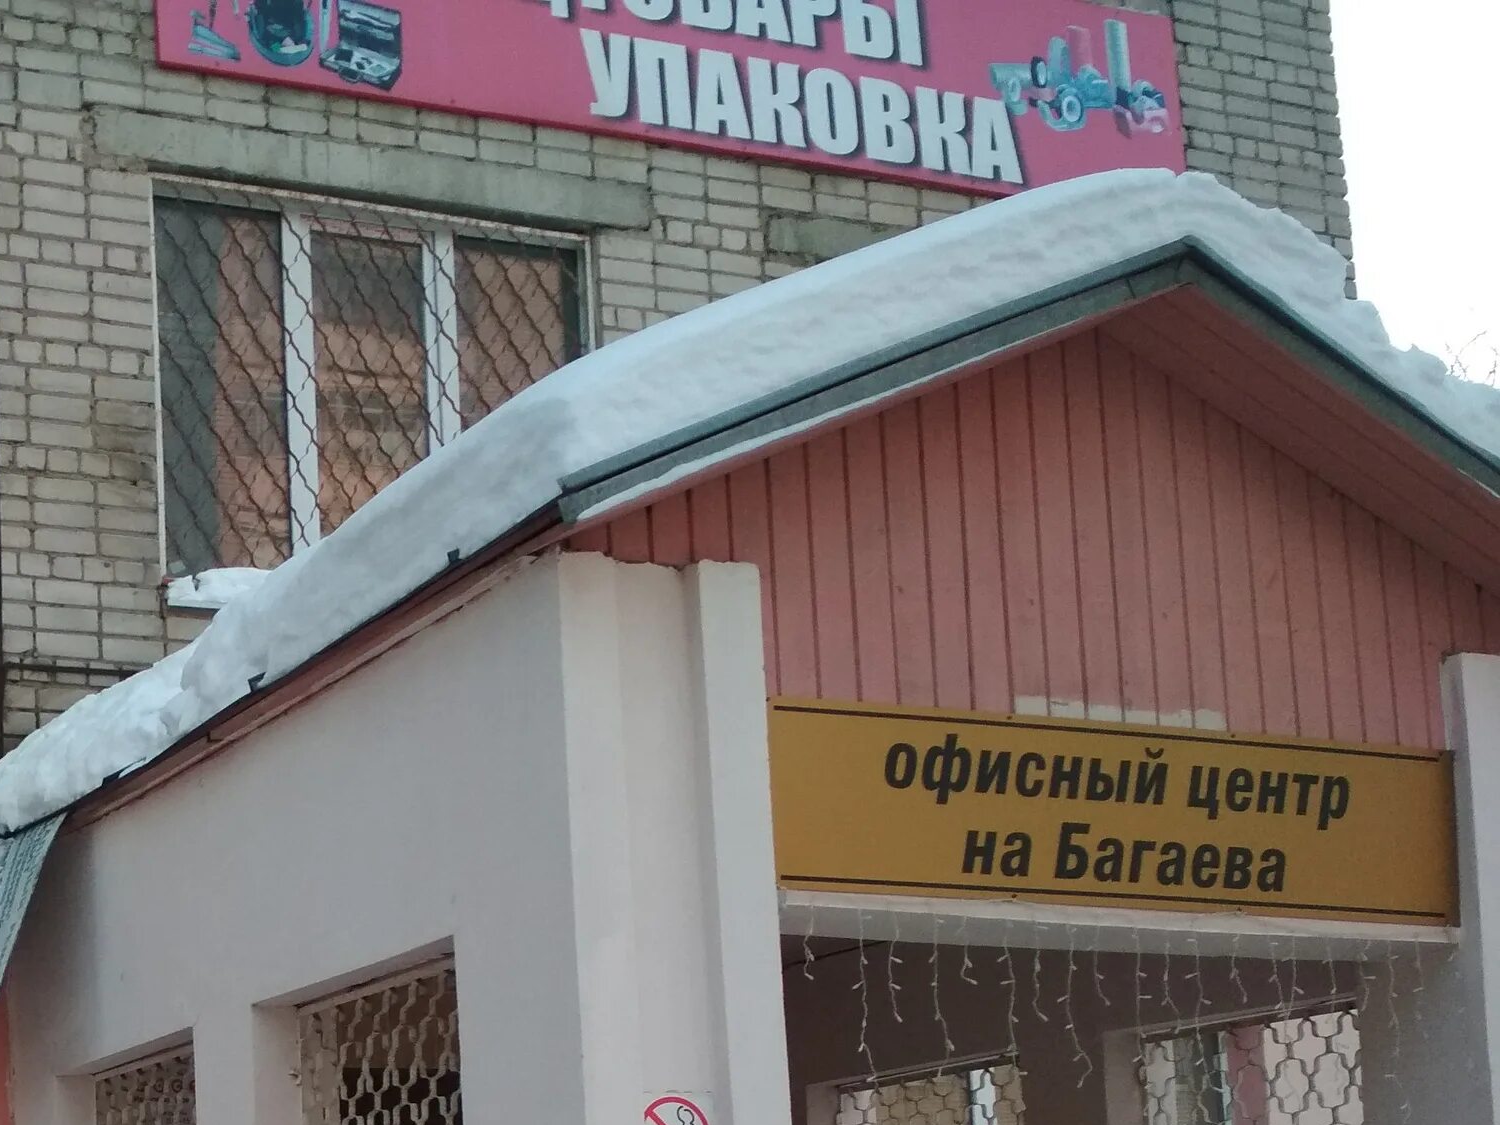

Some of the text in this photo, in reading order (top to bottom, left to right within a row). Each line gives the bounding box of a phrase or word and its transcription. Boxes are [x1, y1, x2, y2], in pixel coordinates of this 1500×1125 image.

[580, 28, 1023, 184] УПАКОВКА
[883, 733, 1351, 831] офисный центр
[961, 822, 1287, 892] на Багаева
